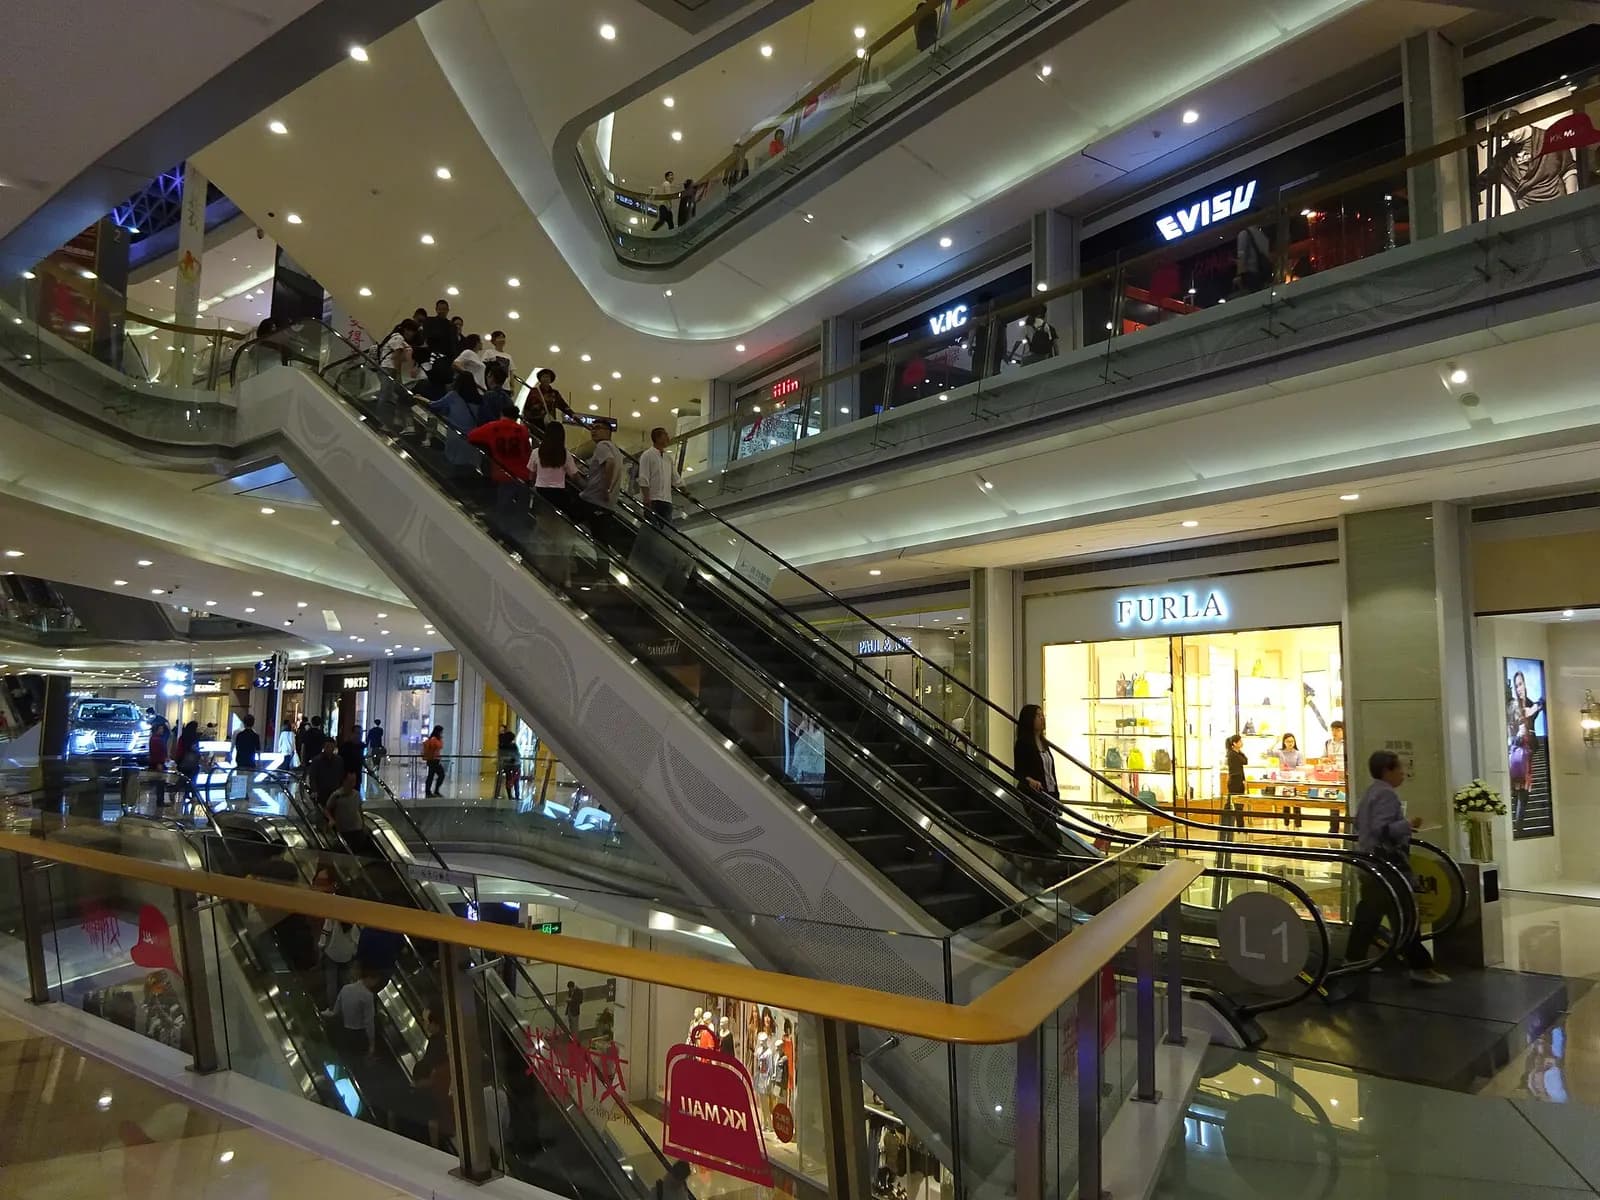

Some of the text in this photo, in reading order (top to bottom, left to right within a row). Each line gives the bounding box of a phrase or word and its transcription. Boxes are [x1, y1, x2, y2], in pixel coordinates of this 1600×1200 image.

[1156, 180, 1256, 241] EVISU
[1117, 593, 1223, 623] FURLA
[859, 640, 881, 654] PAUL
[344, 677, 368, 688] PORTS
[1239, 915, 1288, 963] L1
